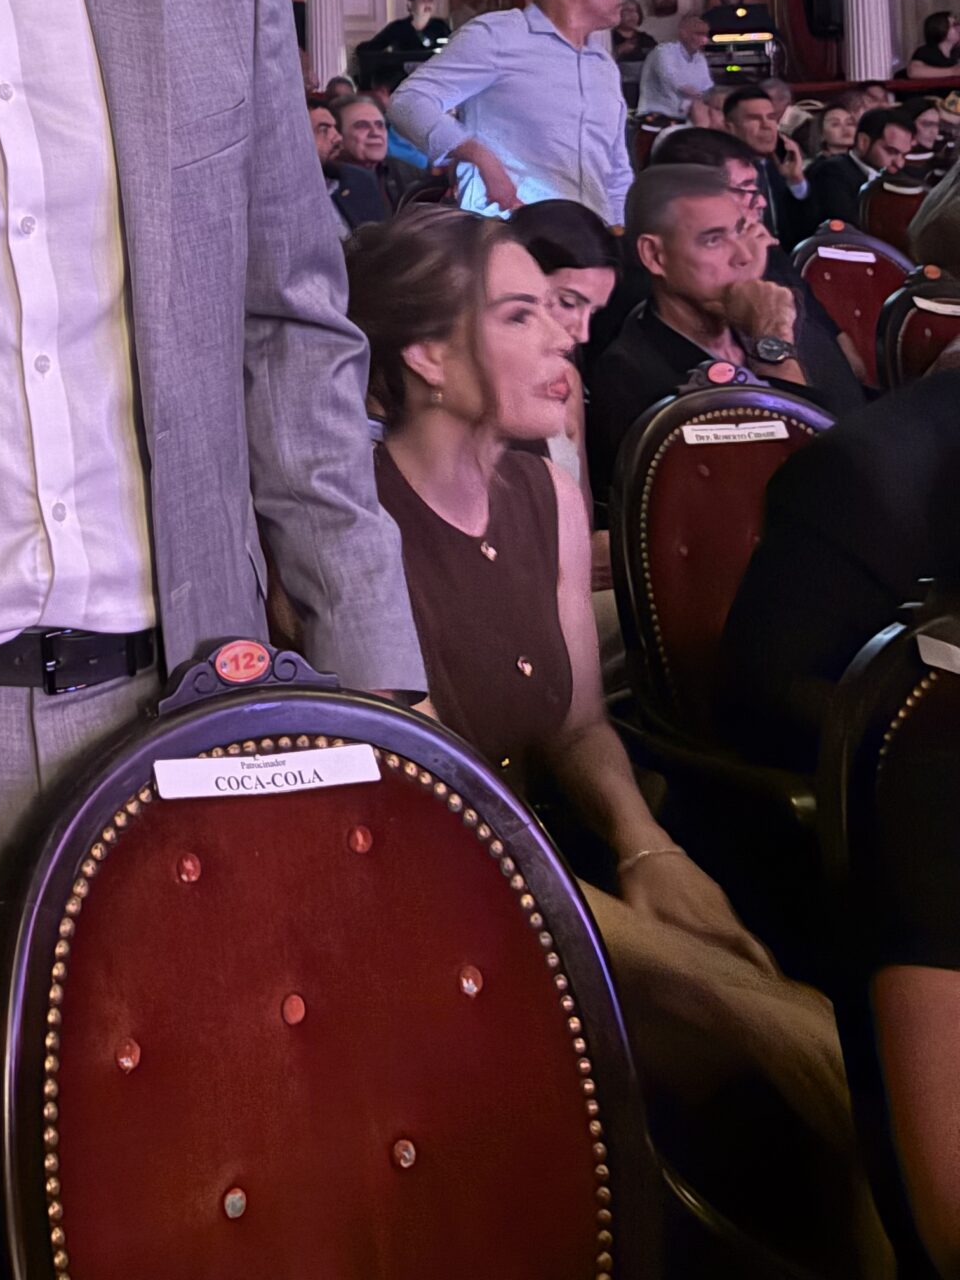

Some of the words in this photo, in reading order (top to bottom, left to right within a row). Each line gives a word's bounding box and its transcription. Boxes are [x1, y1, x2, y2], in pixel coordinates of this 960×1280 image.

[230, 650, 256, 671] 12
[240, 759, 287, 770] Patrocinador
[215, 769, 324, 792] COCA-COLA
